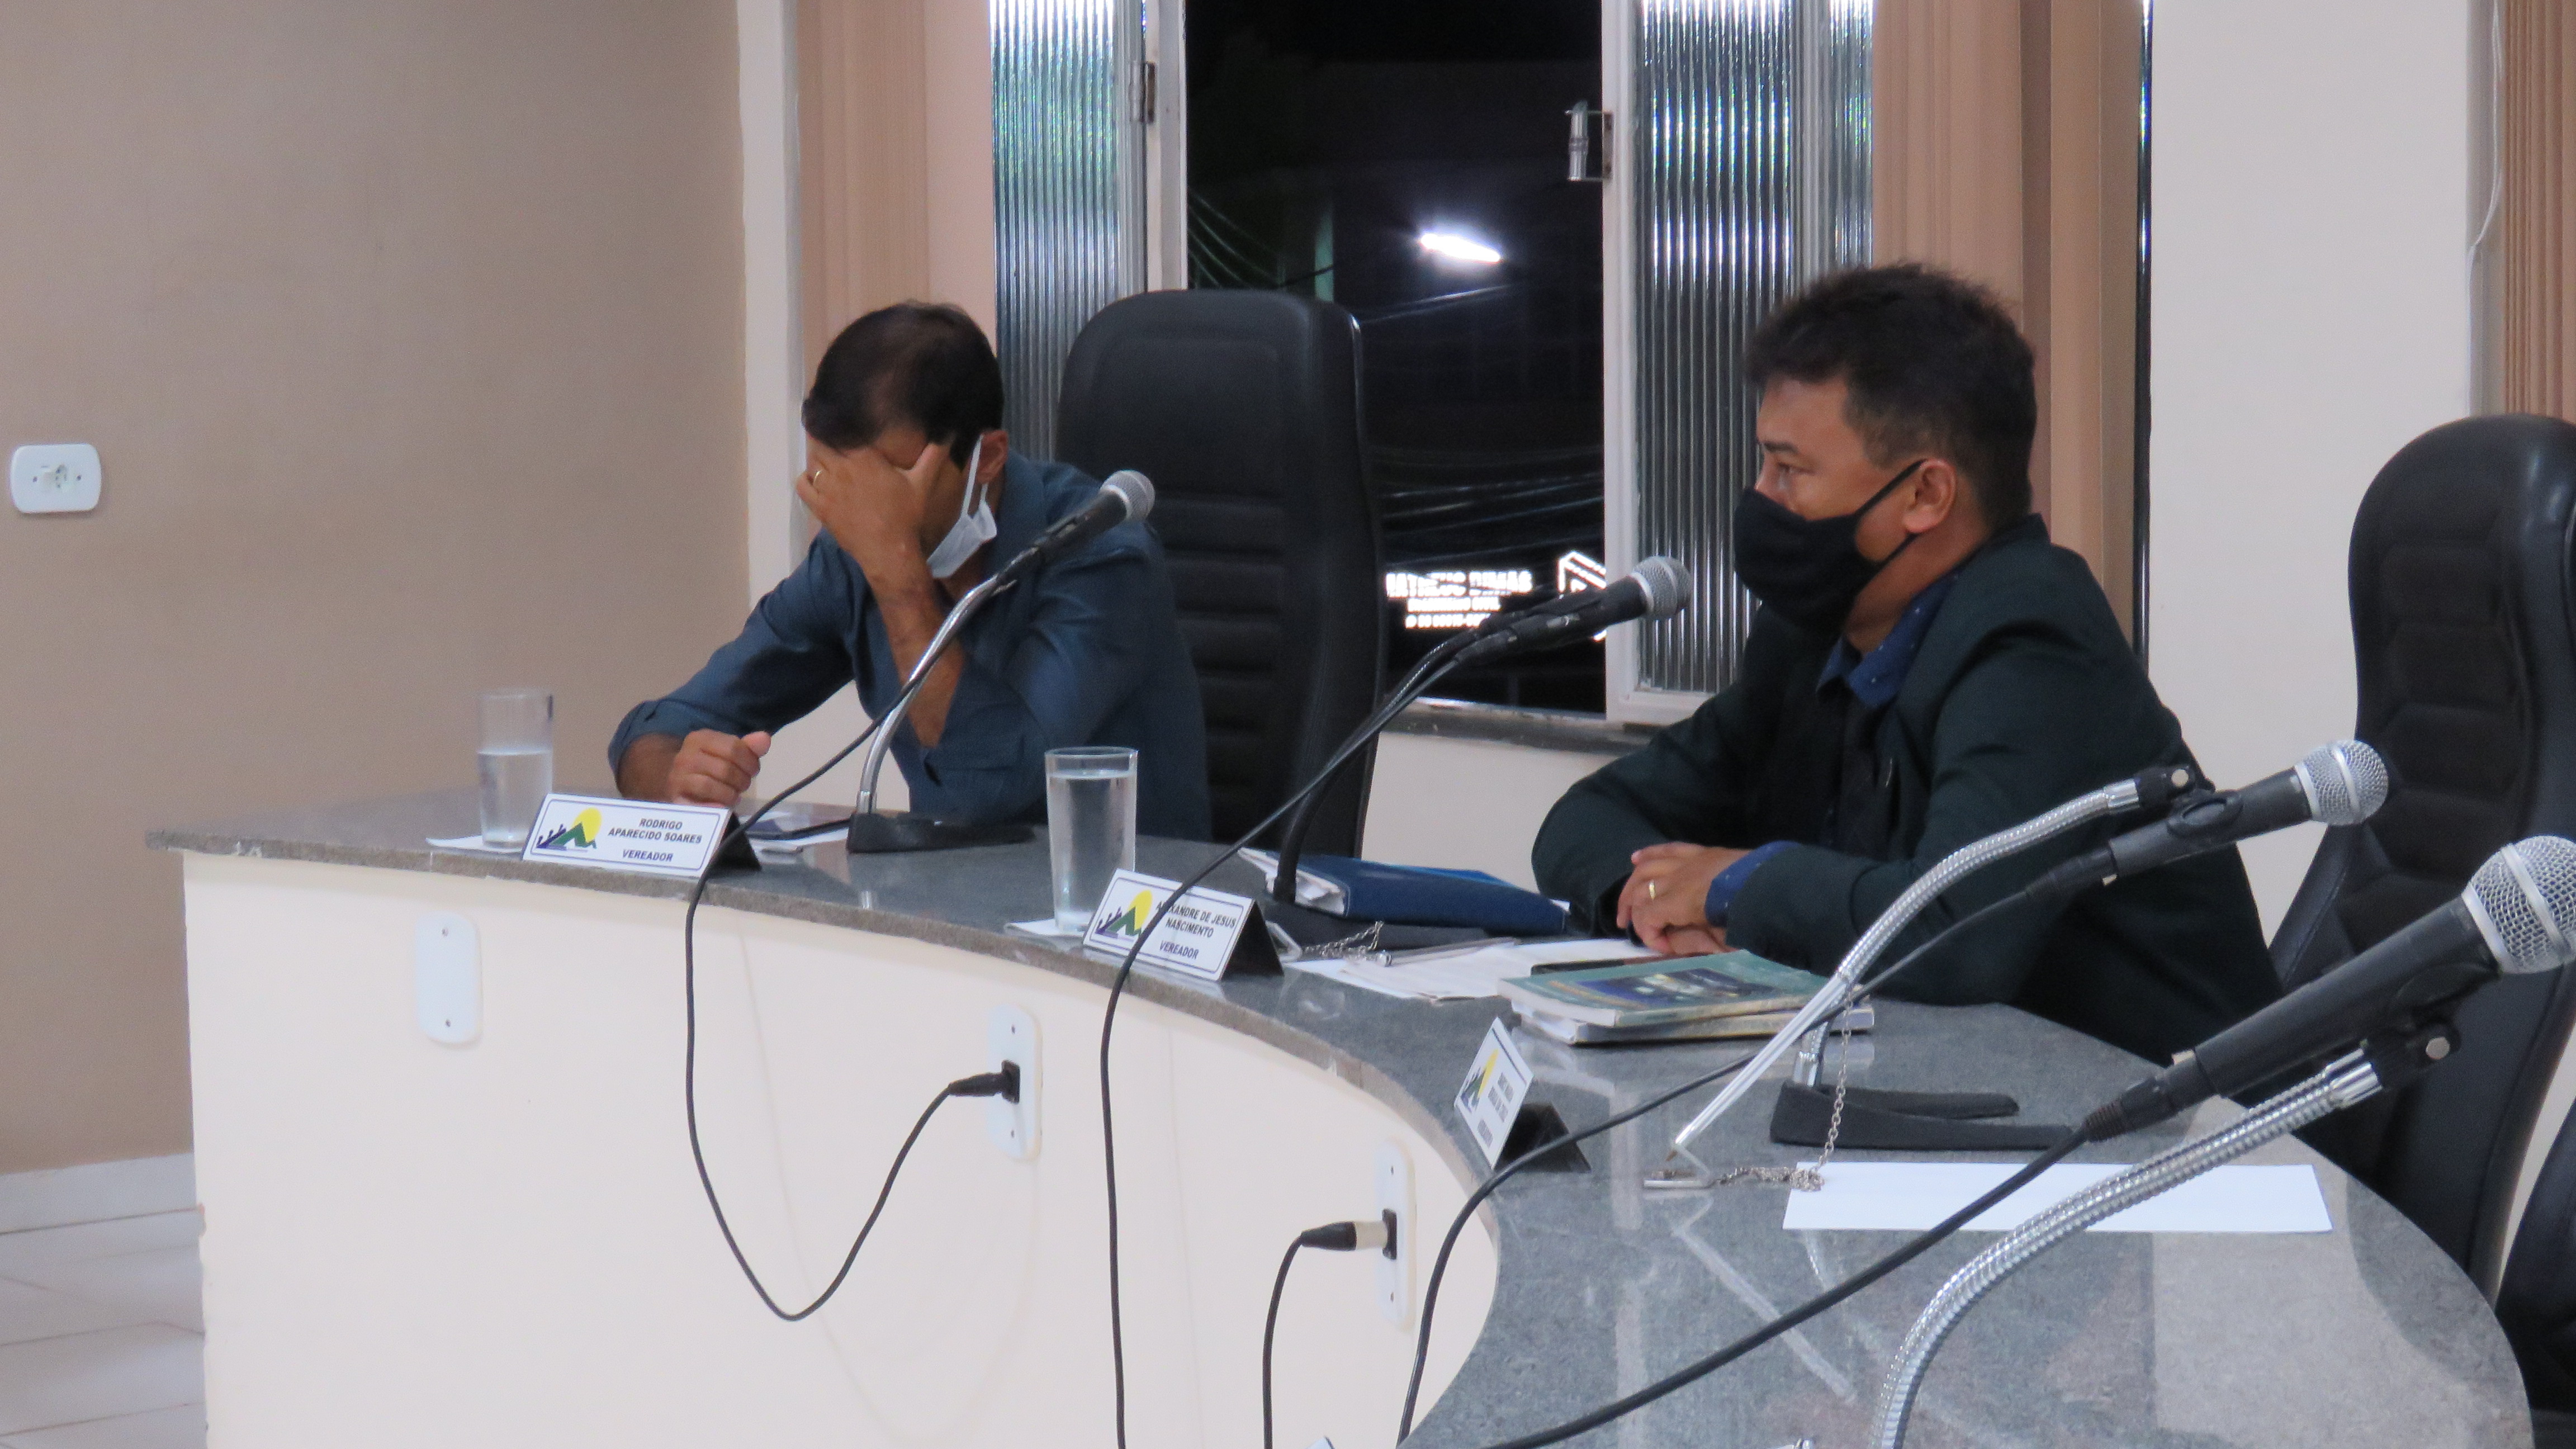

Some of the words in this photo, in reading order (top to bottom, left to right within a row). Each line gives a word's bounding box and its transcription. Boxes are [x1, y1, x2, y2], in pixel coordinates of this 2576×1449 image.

[639, 818, 683, 830] RODRIGO
[608, 827, 662, 840] APARECIDO
[664, 832, 703, 844] SOARES
[622, 849, 674, 862] VEREADOR
[1156, 901, 1200, 919] AXANDRE
[1200, 911, 1211, 922] DE
[1211, 913, 1236, 928] JESUS
[1166, 917, 1214, 937] NASCIMENTO
[1159, 940, 1199, 959] VEREADOR
